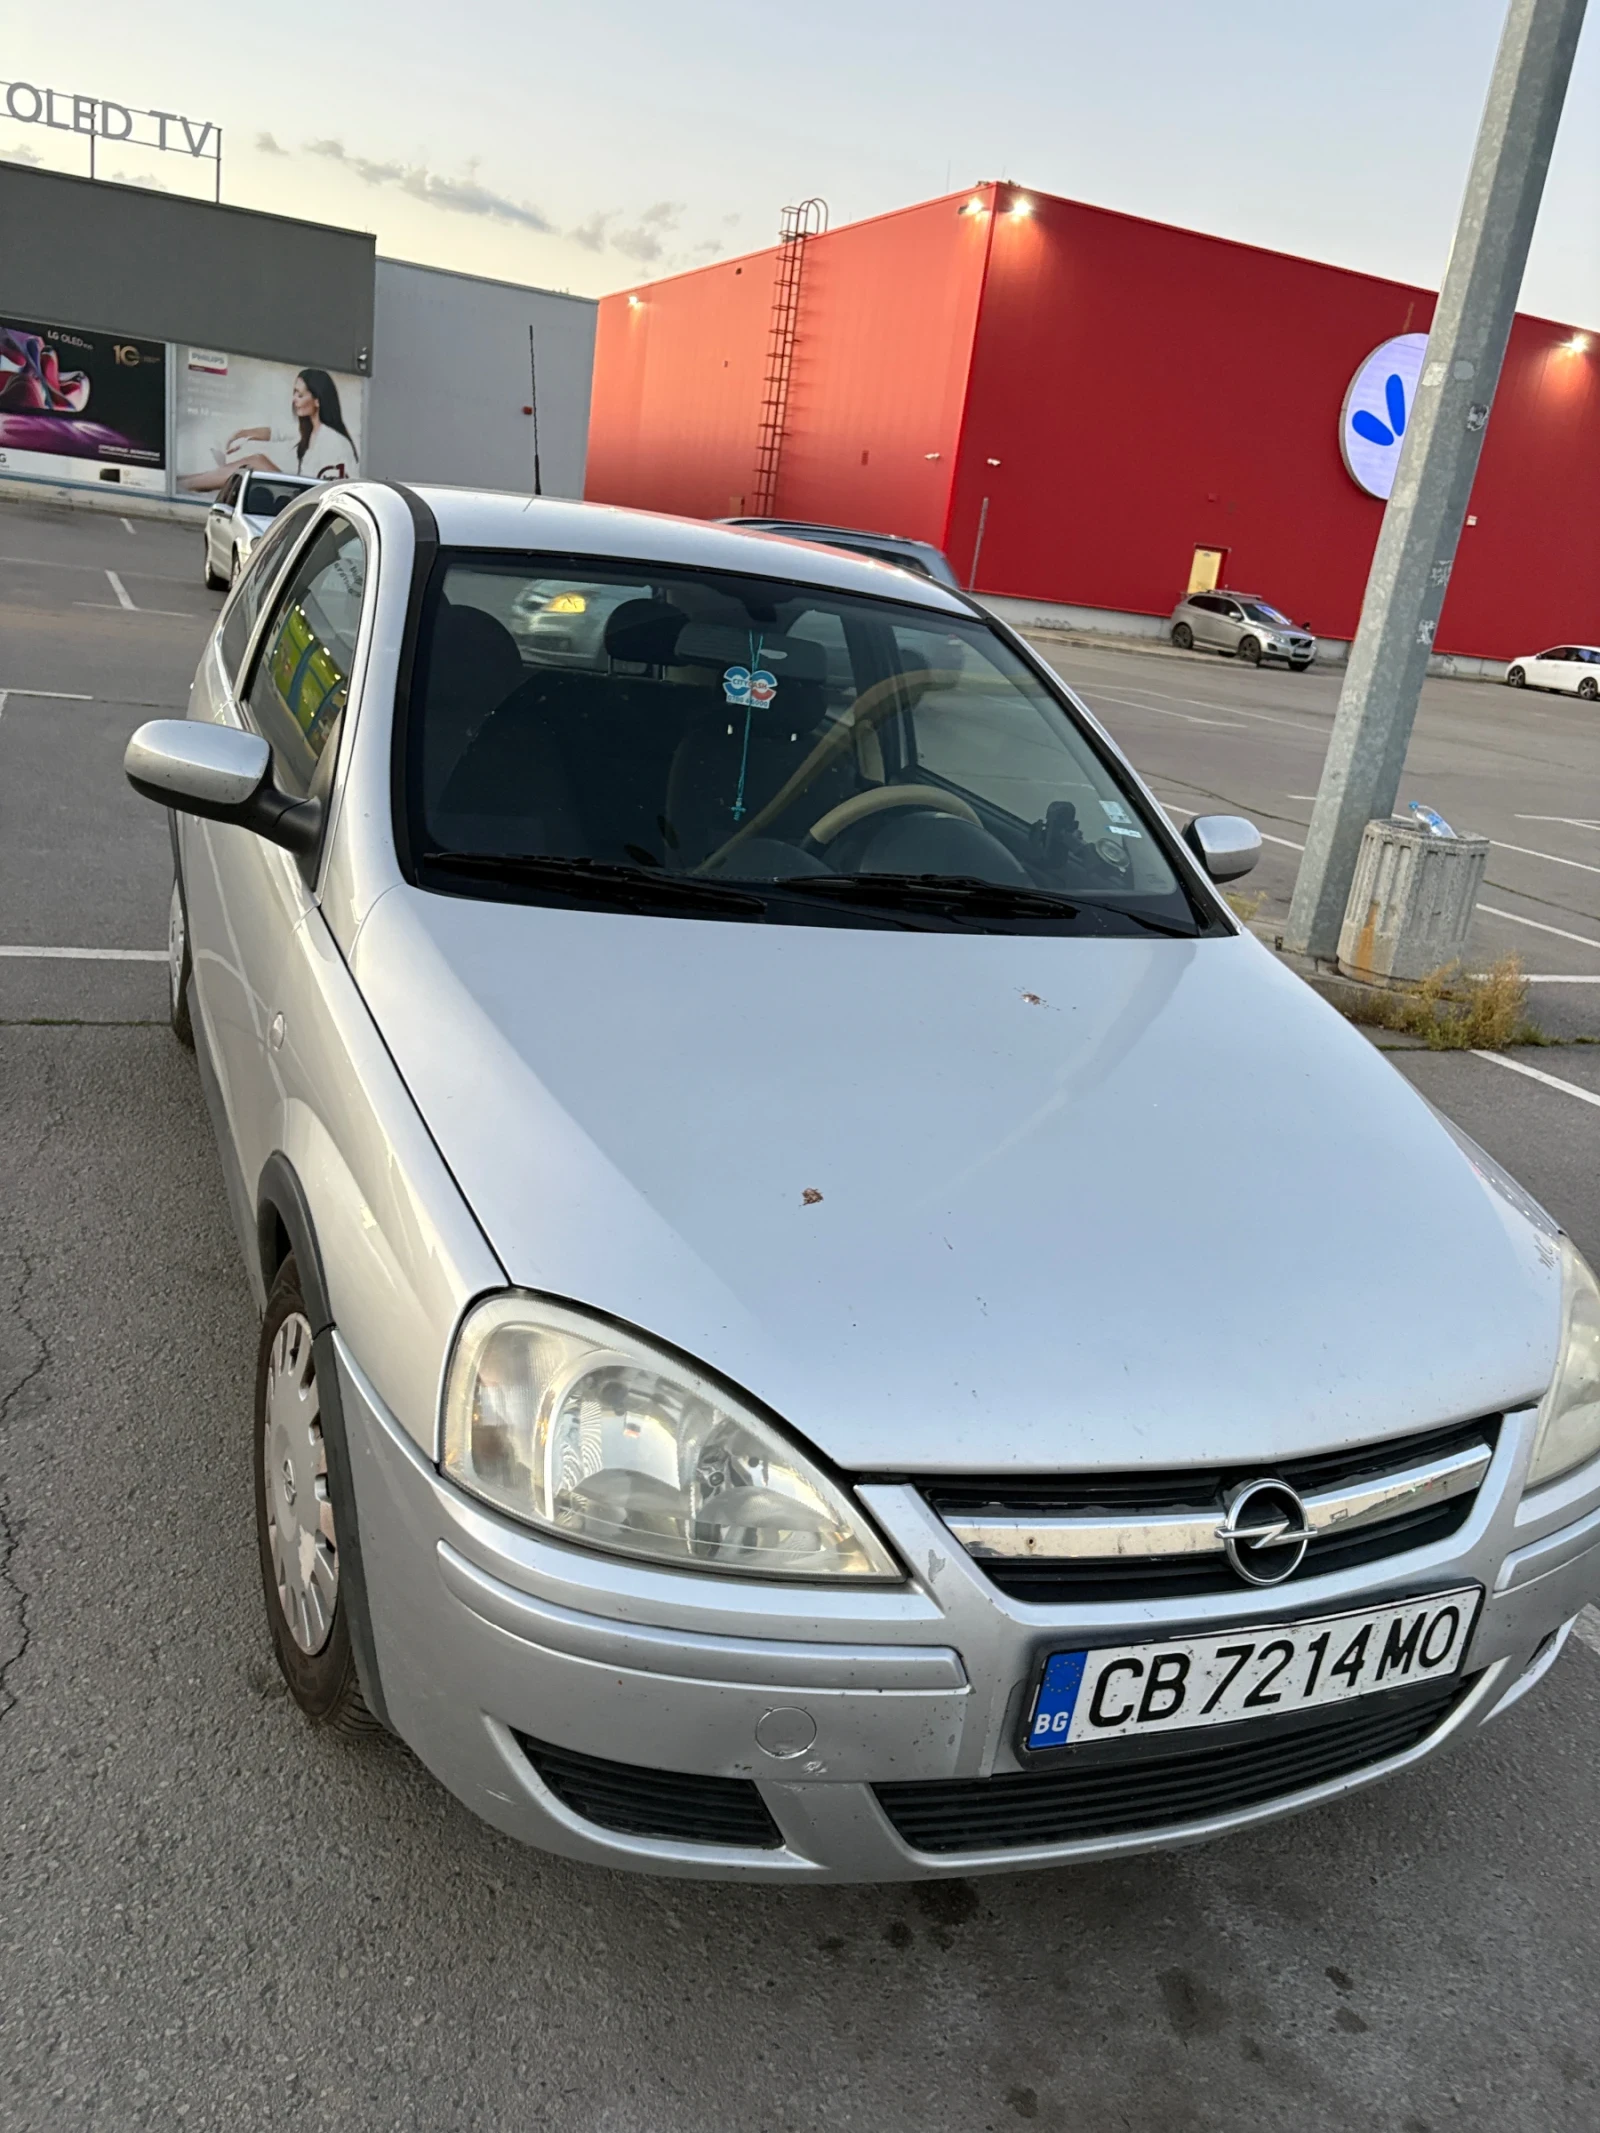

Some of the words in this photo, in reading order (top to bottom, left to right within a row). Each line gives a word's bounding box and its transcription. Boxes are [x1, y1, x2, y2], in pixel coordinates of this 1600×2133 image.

[7, 82, 132, 140] OLED
[149, 110, 213, 157] TV
[47, 329, 59, 340] LG
[60, 333, 83, 347] OLED
[1088, 1652, 1191, 1729] CB
[1199, 1622, 1373, 1715] 7214
[1375, 1606, 1461, 1682] MO
[1033, 1711, 1069, 1735] BG
